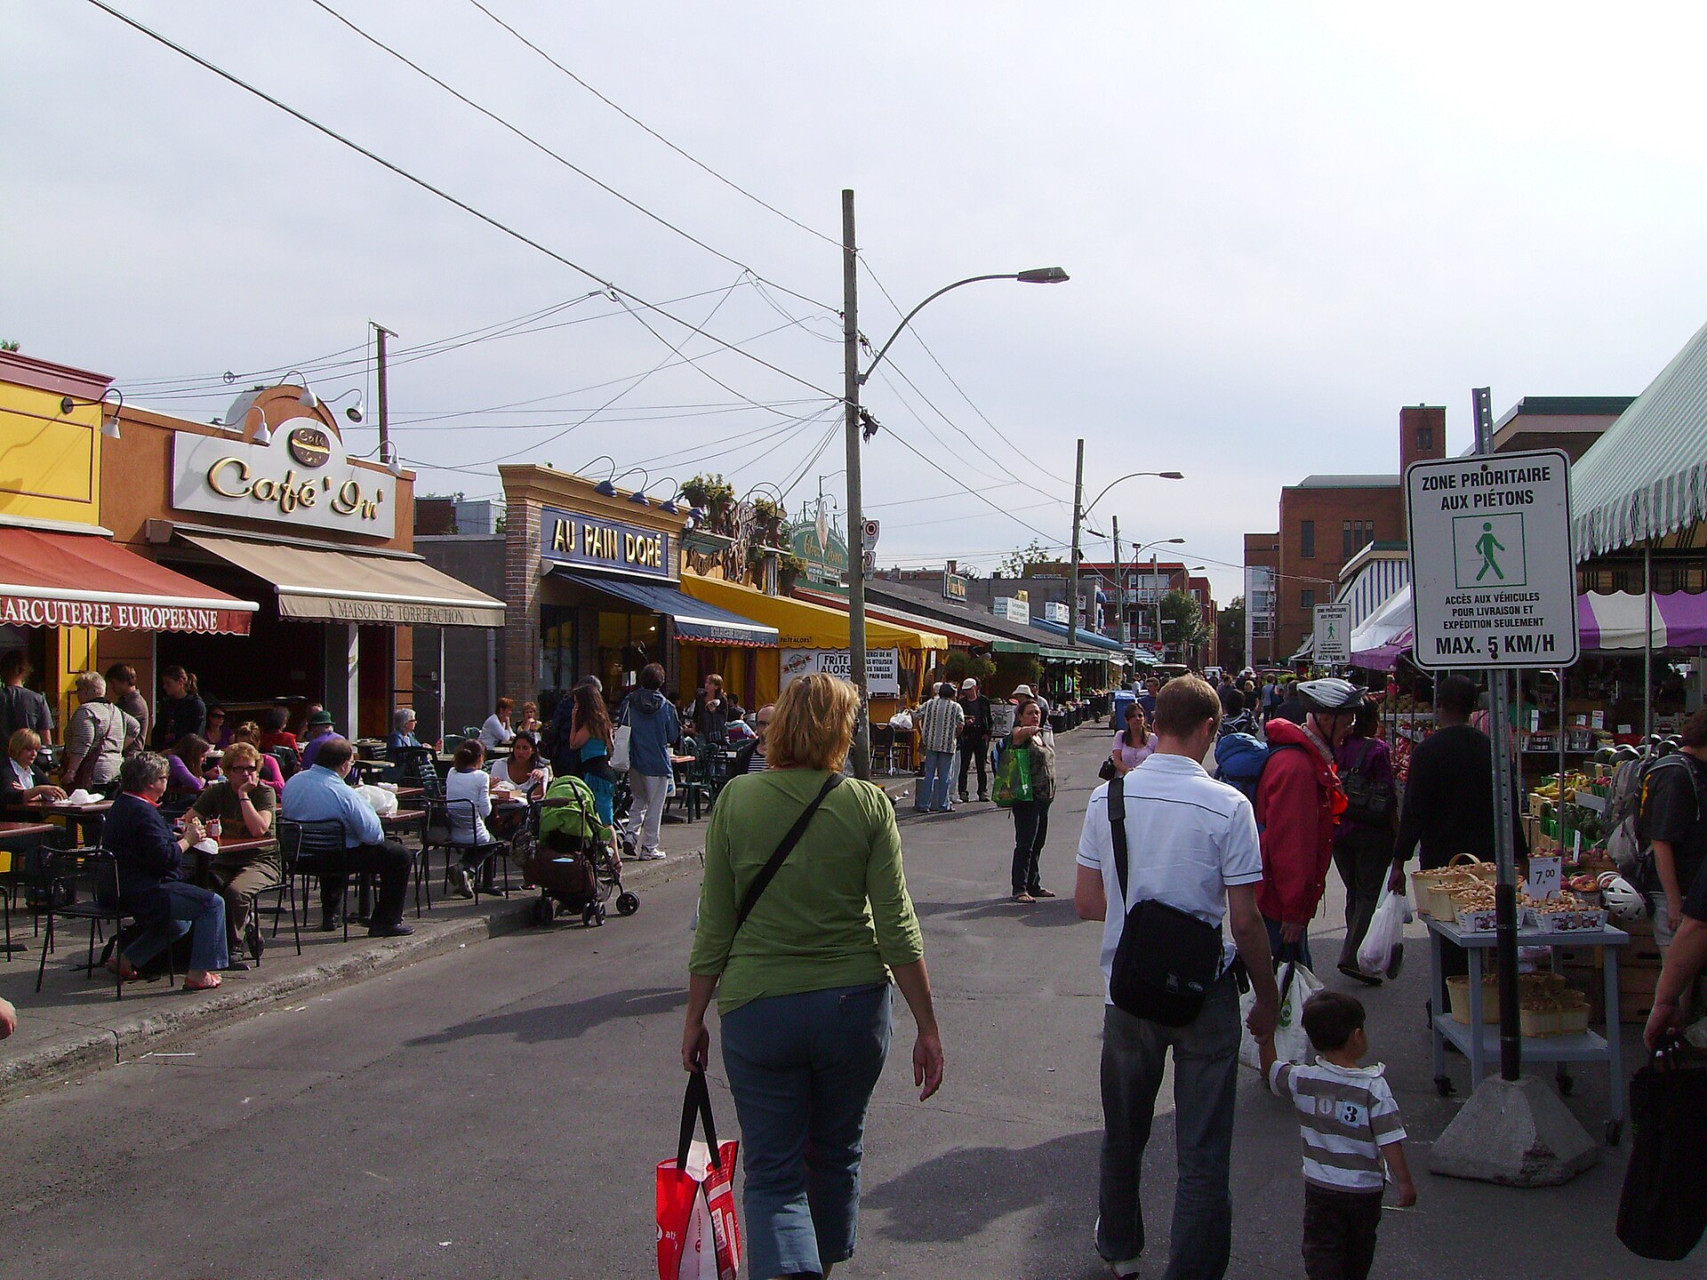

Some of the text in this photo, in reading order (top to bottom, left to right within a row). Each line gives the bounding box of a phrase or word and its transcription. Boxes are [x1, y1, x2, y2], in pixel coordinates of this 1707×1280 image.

[208, 457, 317, 514] Café
[1422, 466, 1551, 491] ZONE PRIORITAIRE
[1441, 489, 1534, 510] AUX PIÉTONS
[553, 519, 661, 568] AU PAIN DORÉ
[1445, 592, 1540, 605] ACCÈS AUX VÉHICULES
[117, 605, 218, 630] EUROPÉENNE
[338, 601, 379, 619] MAISON
[381, 604, 394, 620] DE
[1452, 605, 1534, 617] POUR LIVRAISON ET
[1443, 617, 1544, 629] EXPÉDITION SEULEMENT
[1436, 634, 1555, 654] MAX. 5 KM/H
